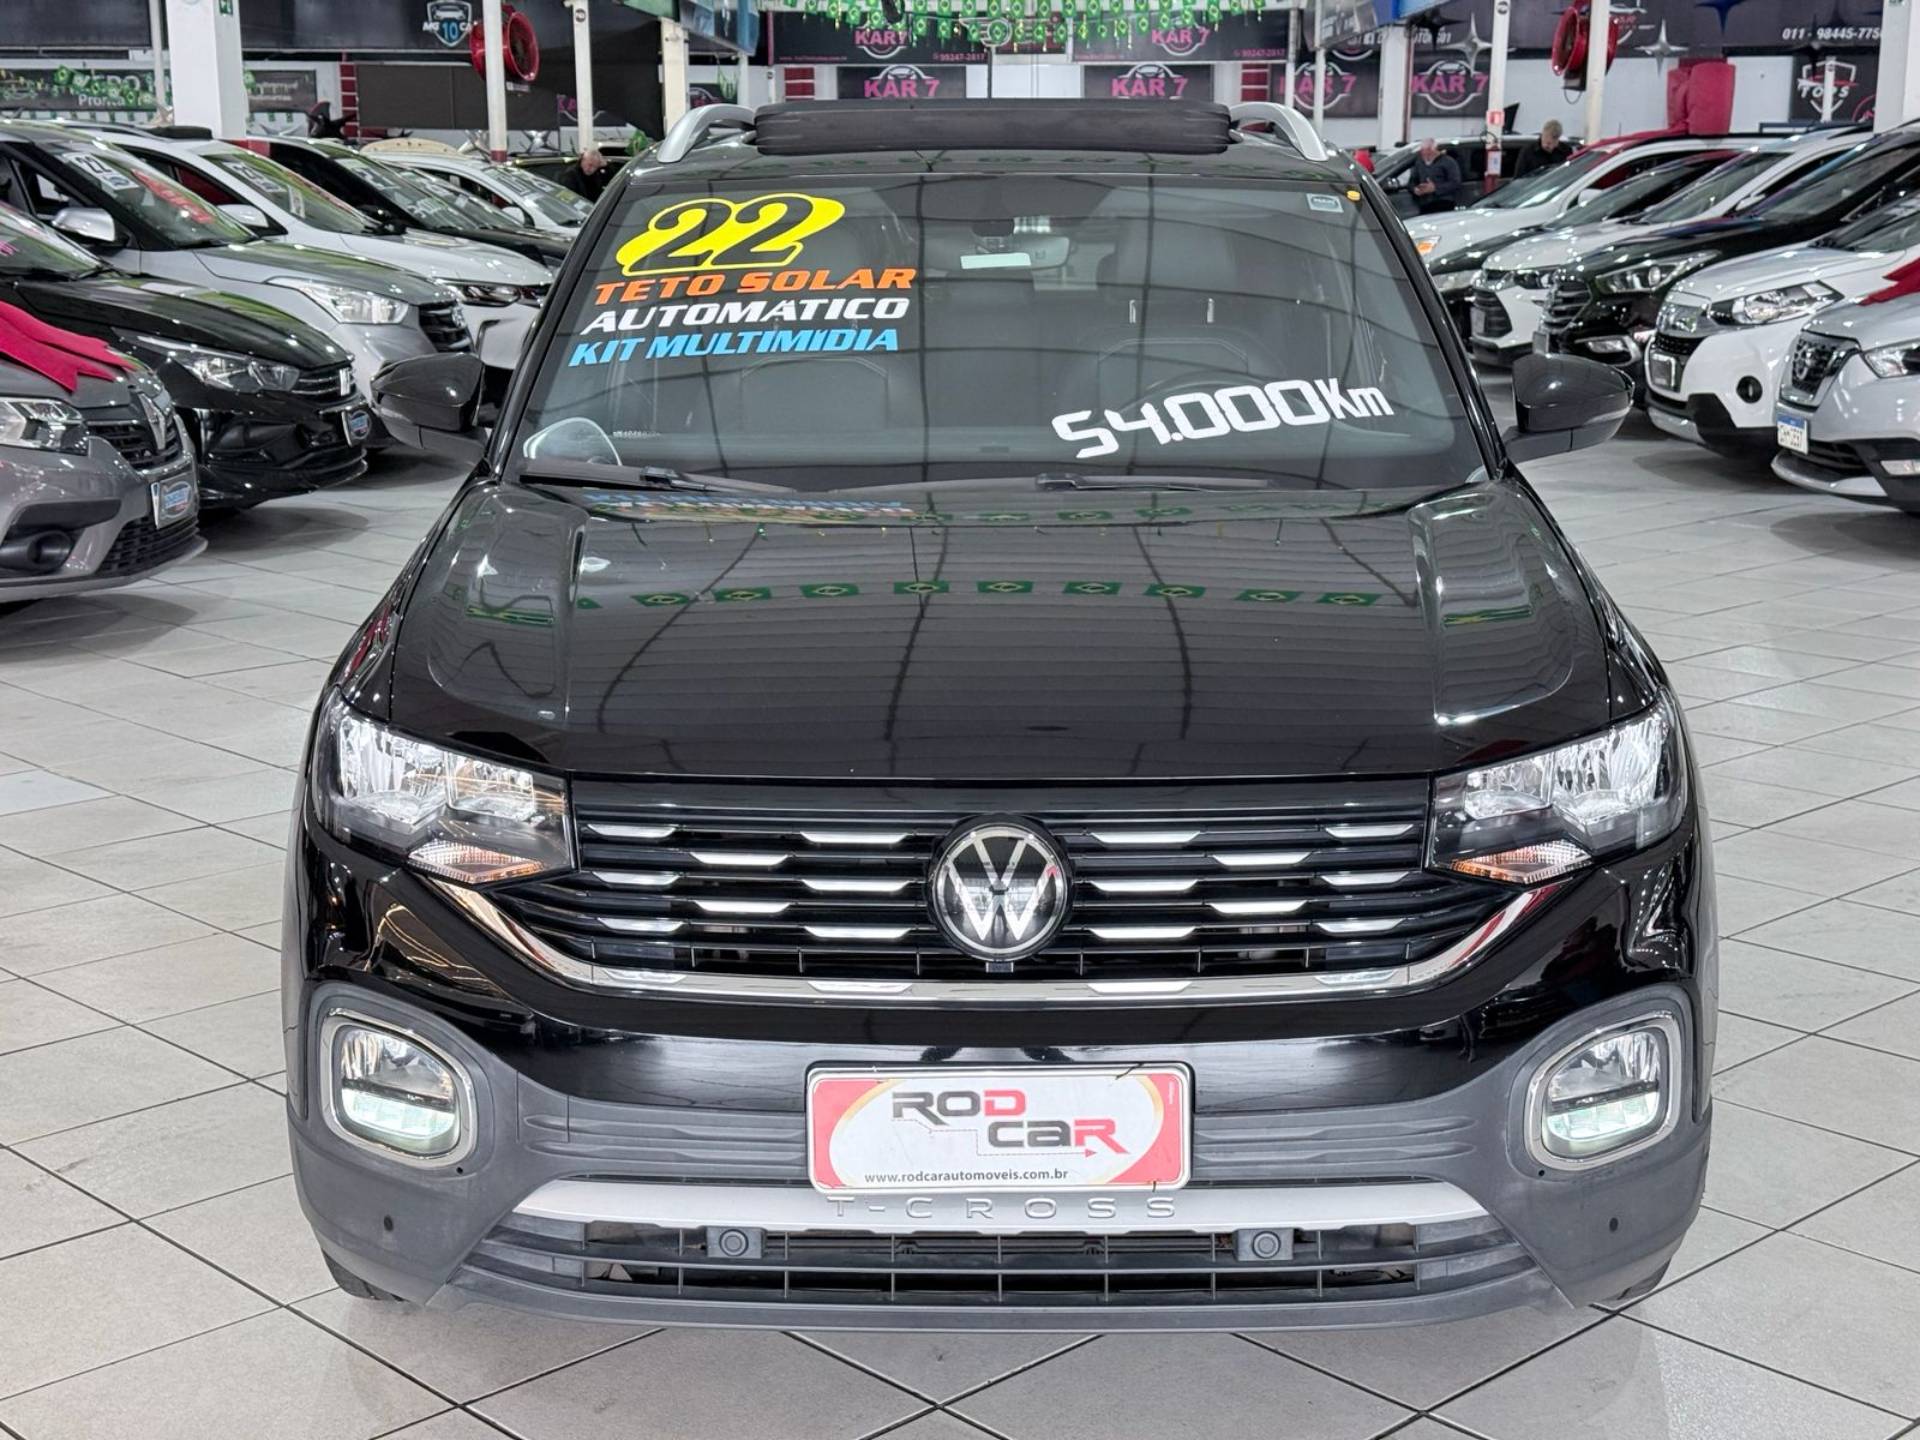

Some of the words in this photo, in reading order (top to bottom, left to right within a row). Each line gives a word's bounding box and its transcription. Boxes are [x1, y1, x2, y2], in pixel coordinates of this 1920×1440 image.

[442, 22, 459, 40] 10
[855, 31, 897, 45] KAR
[1151, 29, 1193, 45] KAR
[1782, 28, 1806, 40] 011
[864, 79, 918, 98] KAR
[925, 79, 940, 98] 7
[1110, 78, 1168, 97] KAR
[1172, 77, 1189, 97] 7
[1342, 75, 1358, 94] 7
[1411, 75, 1465, 93] KAR
[1475, 75, 1489, 93] 7
[1799, 85, 1850, 99] TOS
[616, 193, 845, 276] 22
[594, 274, 726, 306] TETO
[737, 268, 917, 294] SOLAR
[568, 337, 645, 367] KIT
[892, 1089, 1026, 1126] ROD
[864, 1167, 1069, 1184] www.rodcarautomoveis.com.br
[827, 1196, 1176, 1220] T-CROSS
